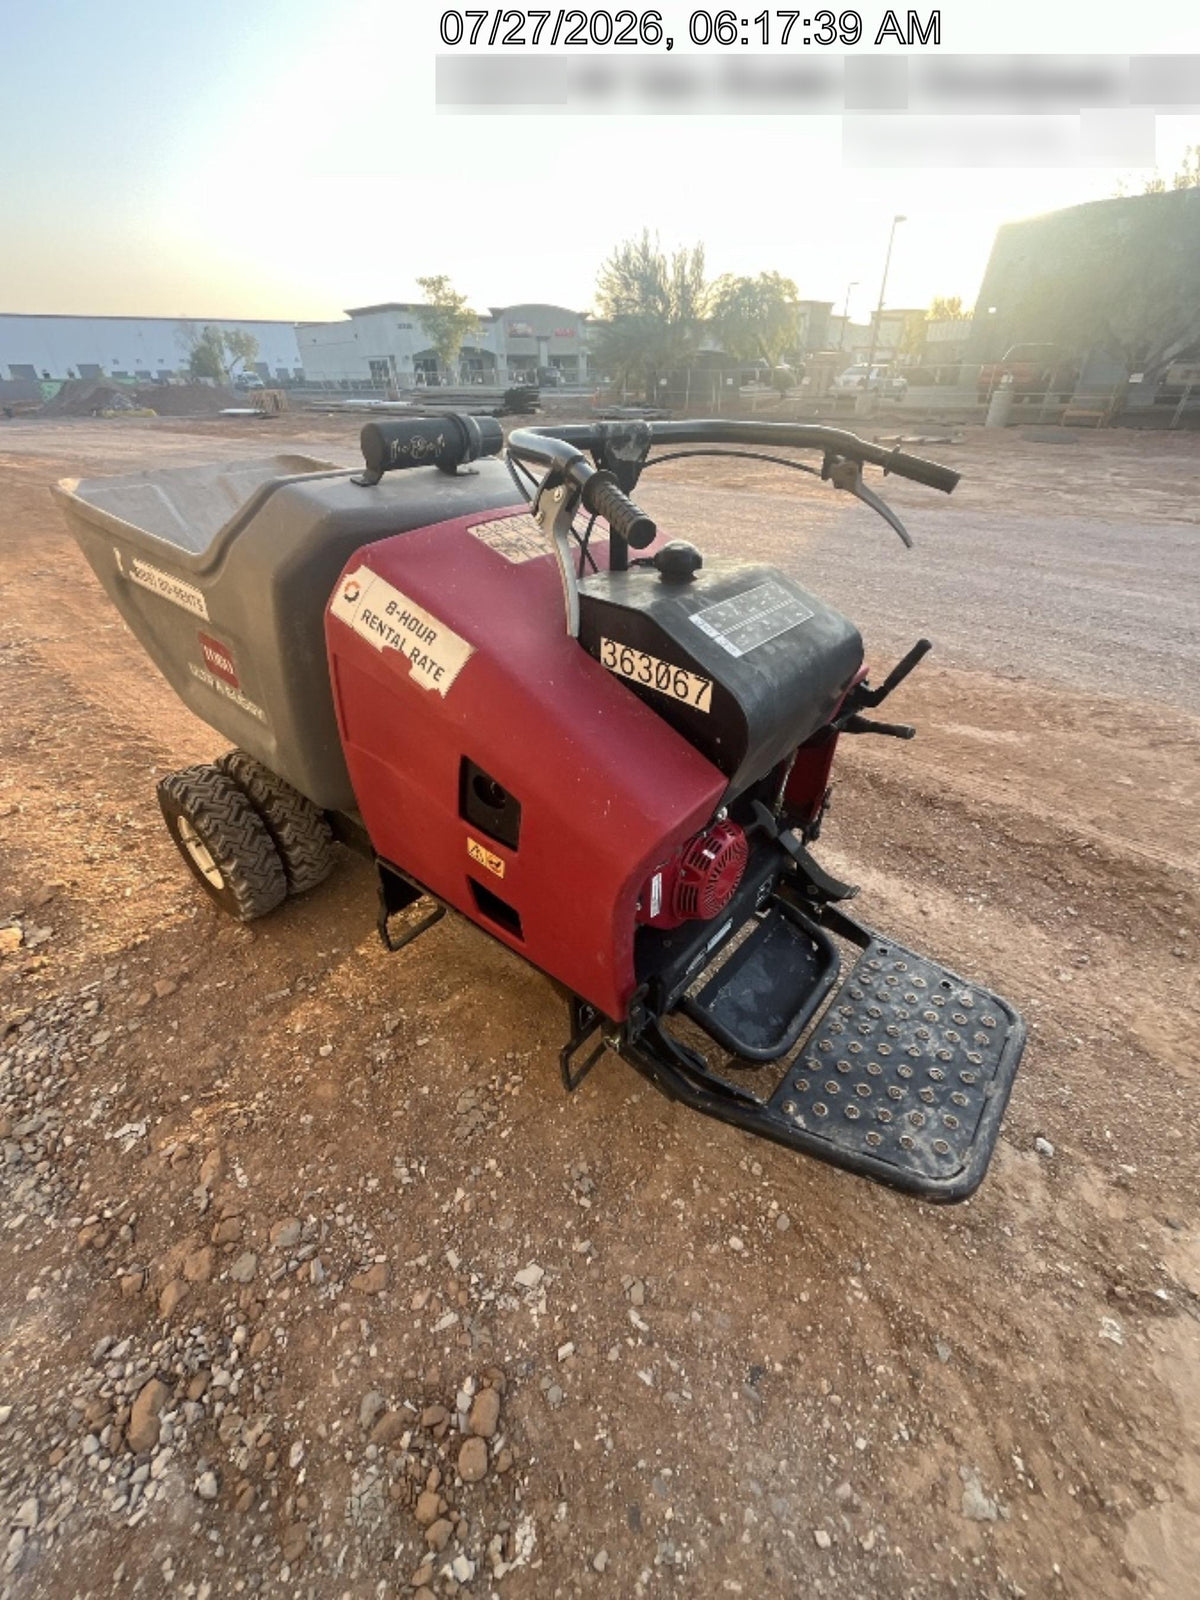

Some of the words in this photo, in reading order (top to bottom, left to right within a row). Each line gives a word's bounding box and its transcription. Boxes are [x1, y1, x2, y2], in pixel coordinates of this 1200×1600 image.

[385, 600, 437, 646] 8-HOUR
[409, 647, 446, 682] RATE
[603, 641, 710, 705] 363067
